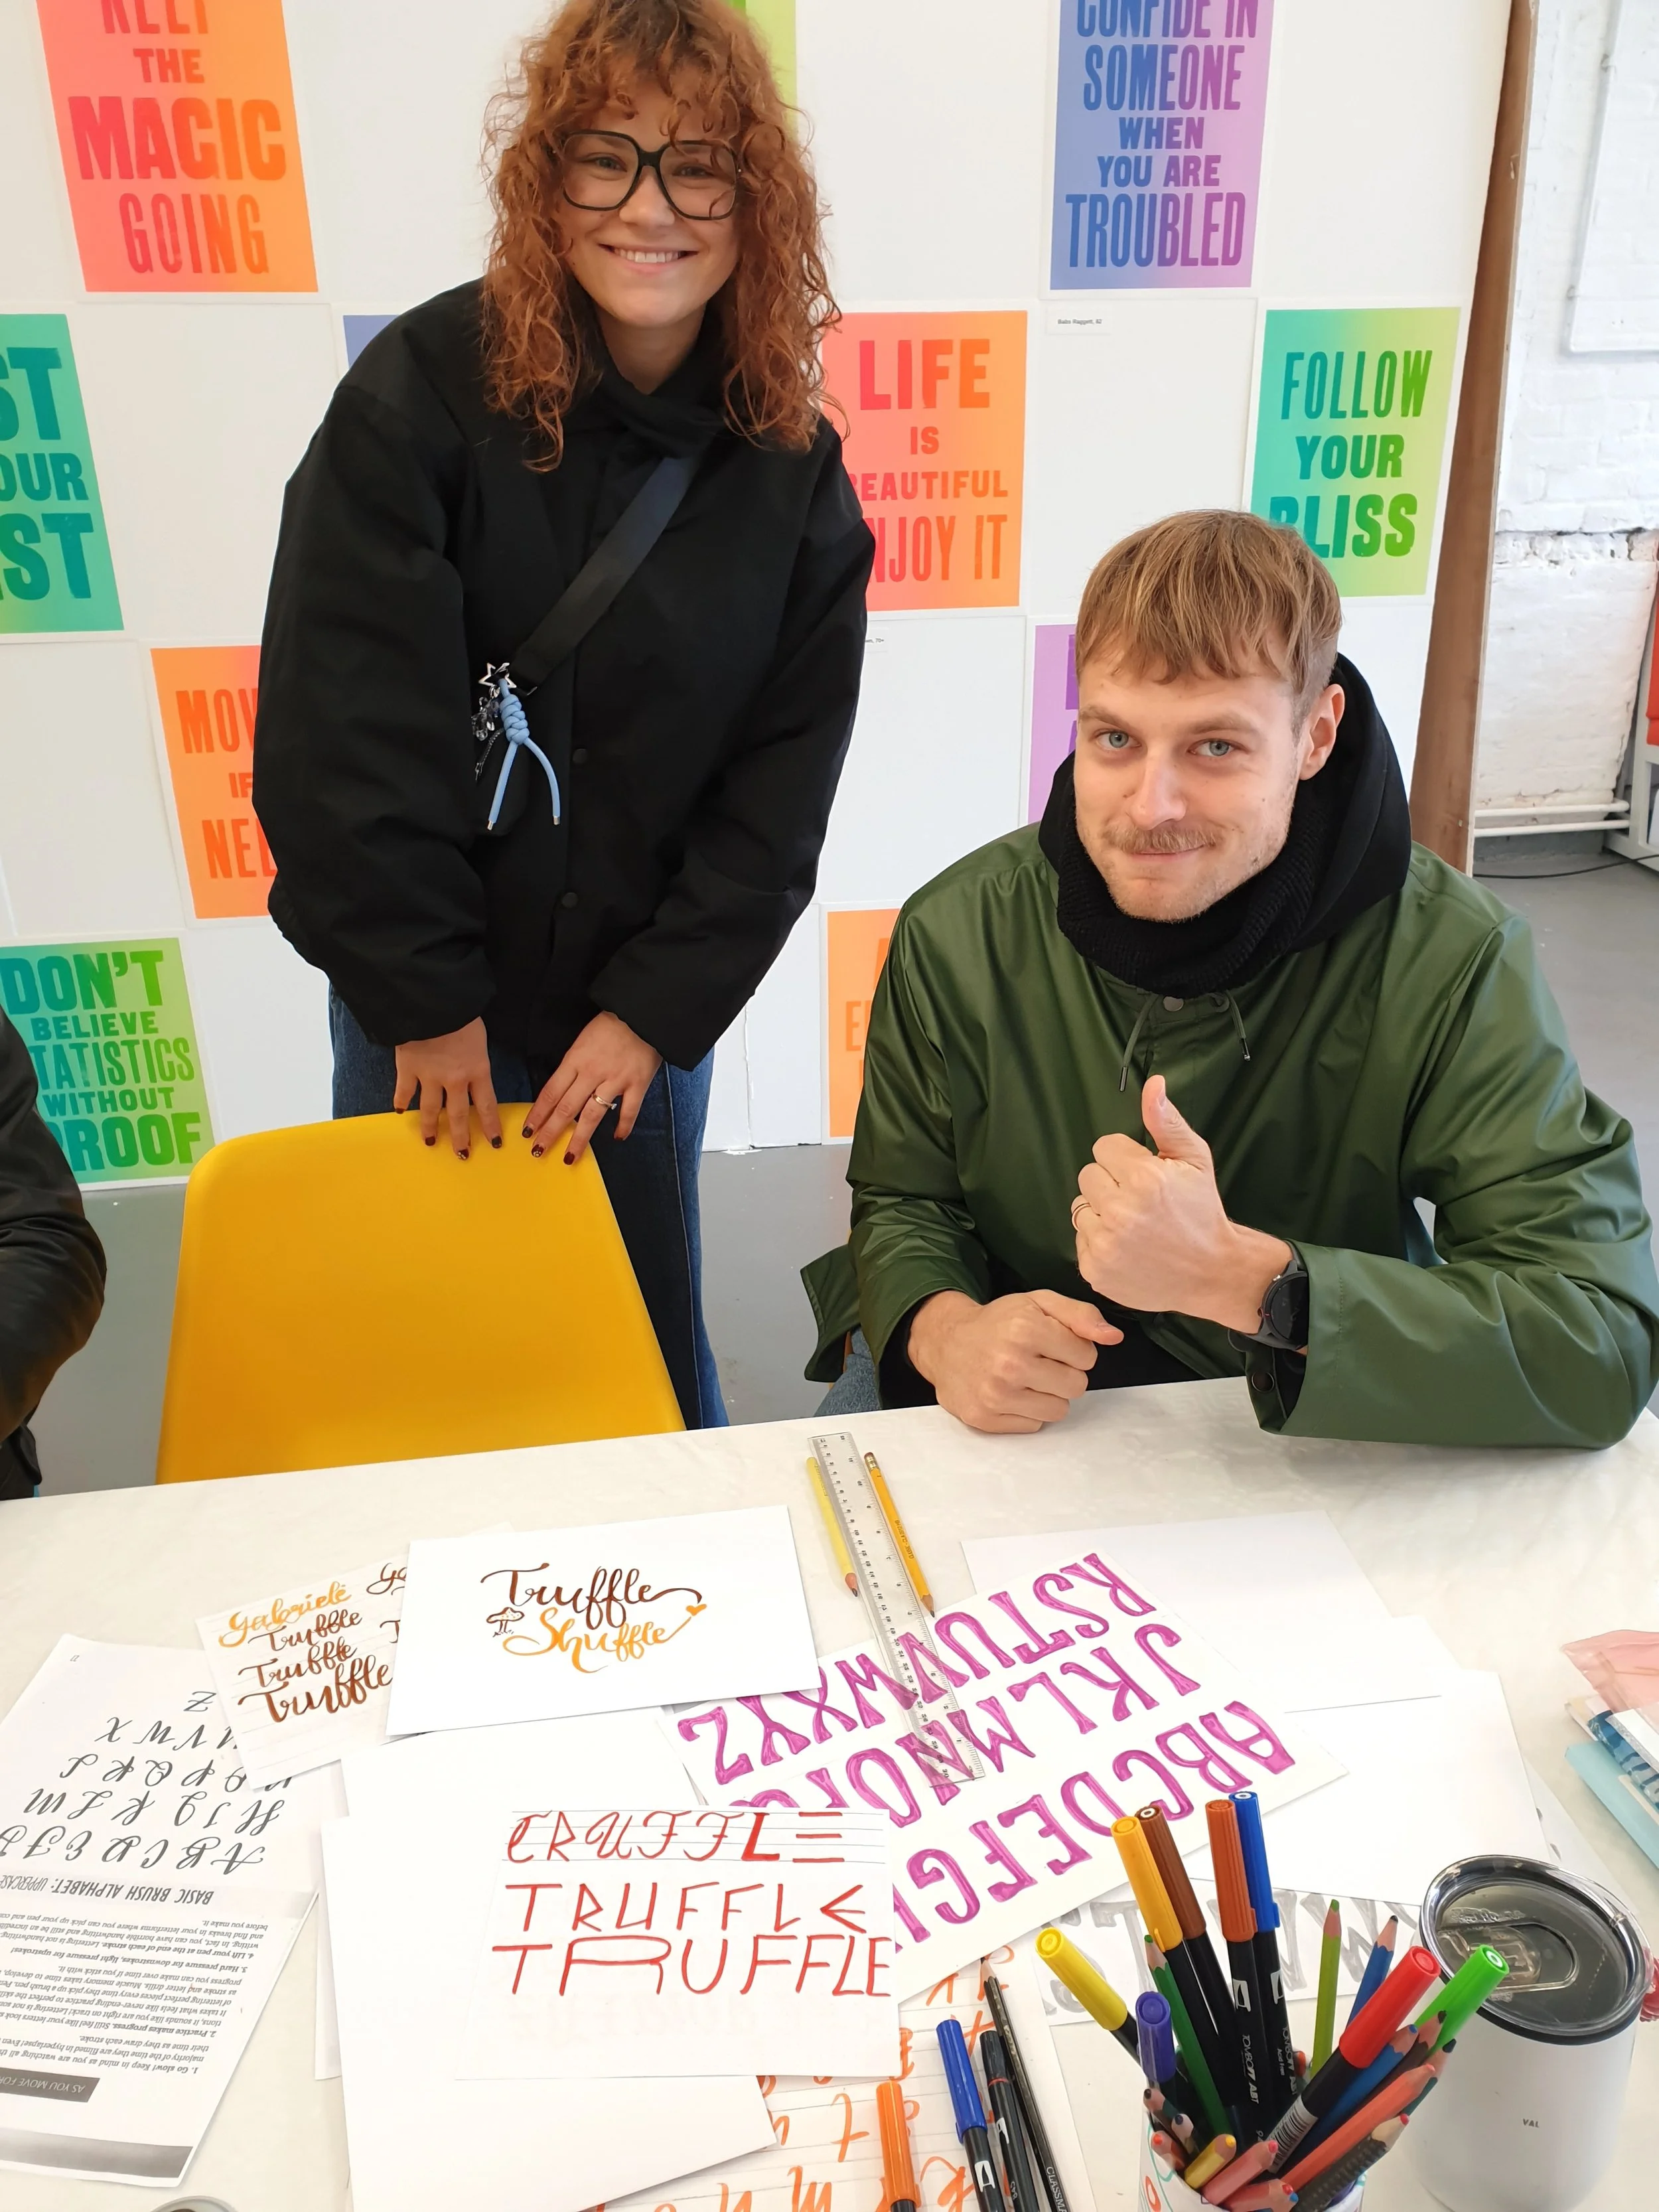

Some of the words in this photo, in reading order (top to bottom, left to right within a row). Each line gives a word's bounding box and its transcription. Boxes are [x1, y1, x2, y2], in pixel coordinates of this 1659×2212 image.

[133, 48, 205, 84] THE
[1083, 44, 1245, 111] SOMEONE
[68, 96, 287, 181] MAGIC
[1119, 117, 1204, 150] WHEN
[1097, 155, 1153, 187] YOU
[1163, 155, 1221, 187] ARE
[119, 192, 269, 274] GOING
[1065, 192, 1246, 267] TROUBLED
[859, 338, 990, 410] LIFE
[1281, 350, 1433, 419] FOLLOW
[910, 426, 939, 455] IS
[1295, 434, 1405, 480] YOUR
[868, 516, 956, 583] NJOY
[974, 514, 1007, 580] IT
[175, 688, 258, 754] MOV
[0, 950, 163, 1015] DON'T
[31, 1011, 159, 1041] BELIEVE
[29, 1037, 195, 1090] TATISTICS
[42, 1086, 175, 1117] WITHOUT
[480, 1562, 702, 1630] Truffle
[248, 1609, 362, 1651] Truffle
[502, 1606, 693, 1673] Shuffle
[238, 1636, 358, 1688] Truffle
[238, 1655, 394, 1723] Truffle
[50, 1878, 124, 1899] ALPHABET:
[125, 1885, 171, 1902] BRUSH
[174, 1889, 214, 1905] BASIC
[505, 1881, 867, 1934] TRUFFLE
[66, 1938, 100, 1948] Lettering
[100, 1955, 119, 1964] light
[121, 1956, 171, 1967] downstrokes,
[492, 1934, 892, 1997] TRUFFLE
[23, 2015, 47, 2024] letters
[175, 2029, 208, 2037] Practice
[21, 2041, 66, 2052] hyperlapse!
[21, 2050, 56, 2061] watching
[74, 2047, 100, 2055] filmed
[112, 2049, 130, 2058] they
[143, 2041, 161, 2049] they
[171, 2054, 205, 2063] majority
[132, 2061, 151, 2071] Keep
[152, 2065, 176, 2073] slow!
[18, 2078, 48, 2089] MOVE
[48, 2082, 70, 2092] YOU
[72, 2085, 86, 2093] AS
[1522, 2118, 1540, 2128] VAL
